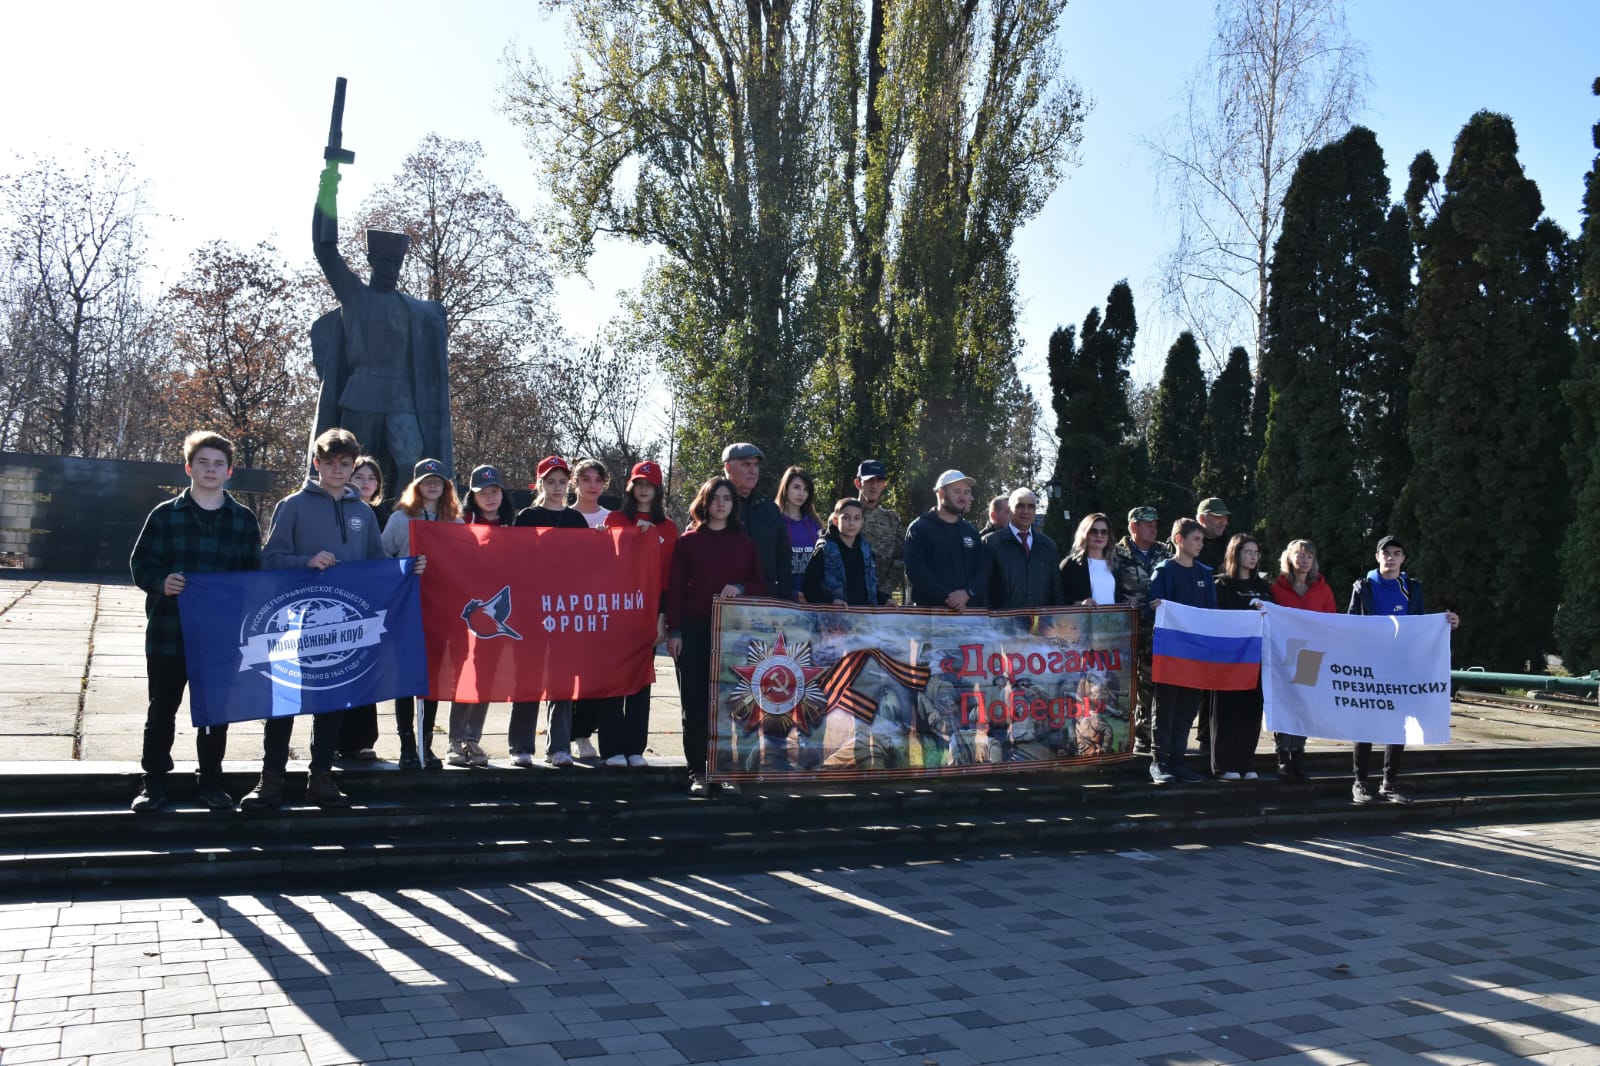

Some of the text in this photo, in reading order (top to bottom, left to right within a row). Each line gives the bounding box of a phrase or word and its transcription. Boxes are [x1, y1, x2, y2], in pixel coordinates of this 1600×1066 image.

[334, 588, 370, 611] ОБЩЕСТВО
[541, 589, 644, 613] НАРОДНЫЙ
[543, 614, 609, 633] ФРОНТ
[266, 625, 364, 653] Молодёжный клуб
[939, 644, 1122, 683] «Дорогами
[1330, 663, 1374, 679] ФОНД
[1332, 680, 1448, 696] ПРЕЗИДЕНТСКИХ
[960, 690, 1107, 729] Победы»
[1335, 696, 1395, 711] ГРАНТОВ
